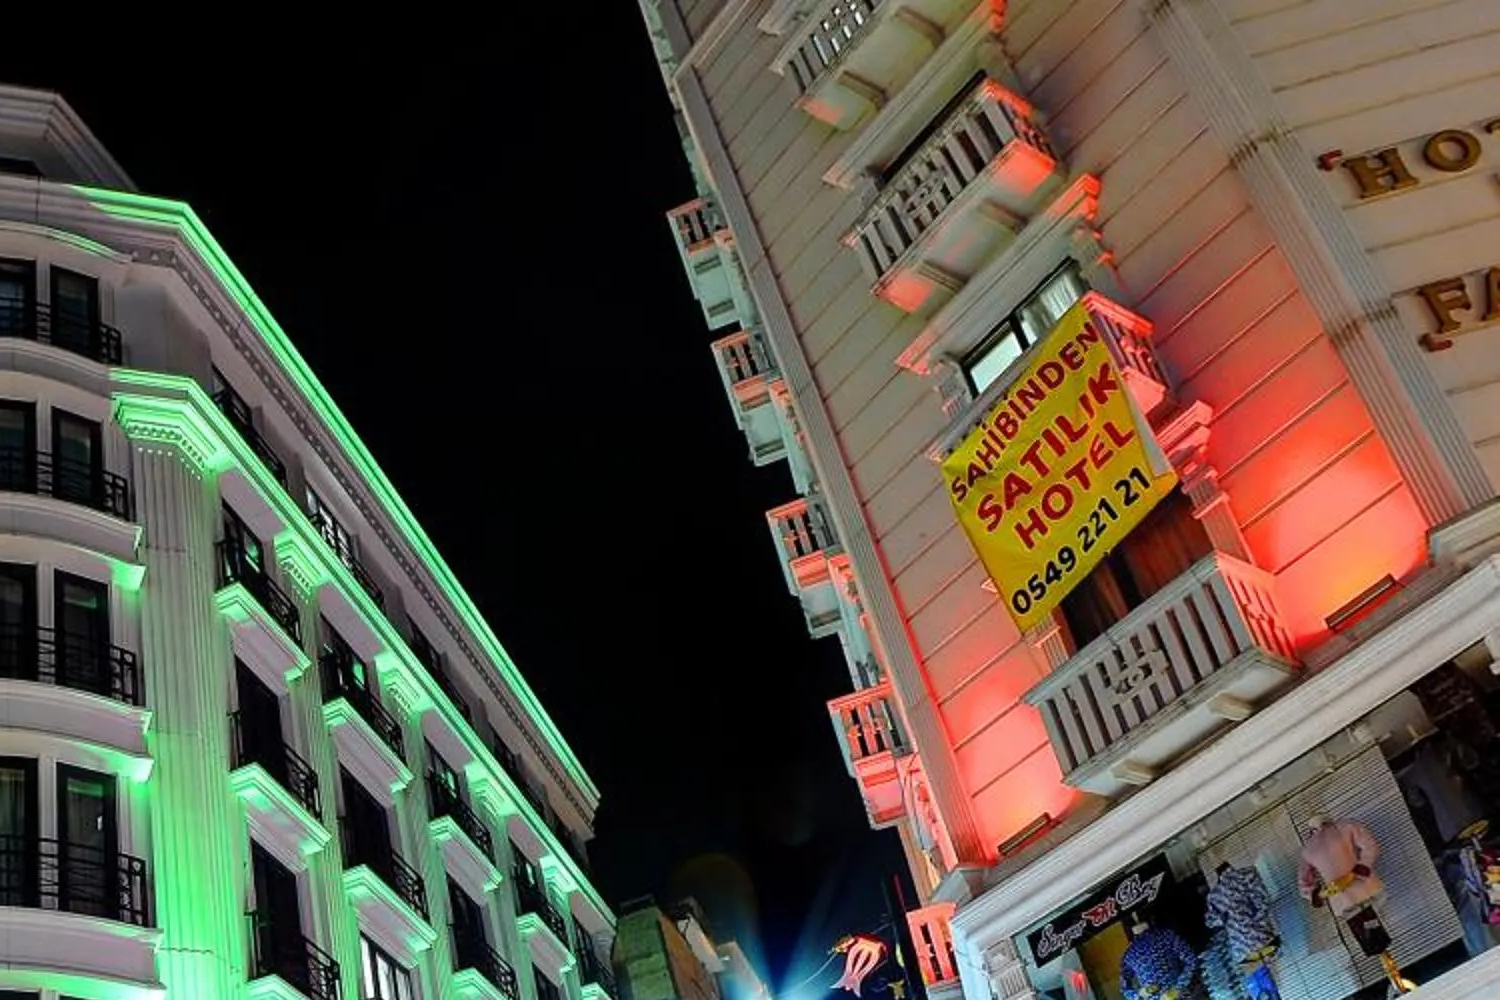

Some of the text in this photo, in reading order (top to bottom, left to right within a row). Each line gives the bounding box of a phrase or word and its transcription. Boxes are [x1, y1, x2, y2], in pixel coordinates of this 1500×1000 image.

[977, 362, 1119, 532] SATILIK
[1014, 421, 1135, 549] HOTEL
[1011, 466, 1151, 615] 0549 221 21
